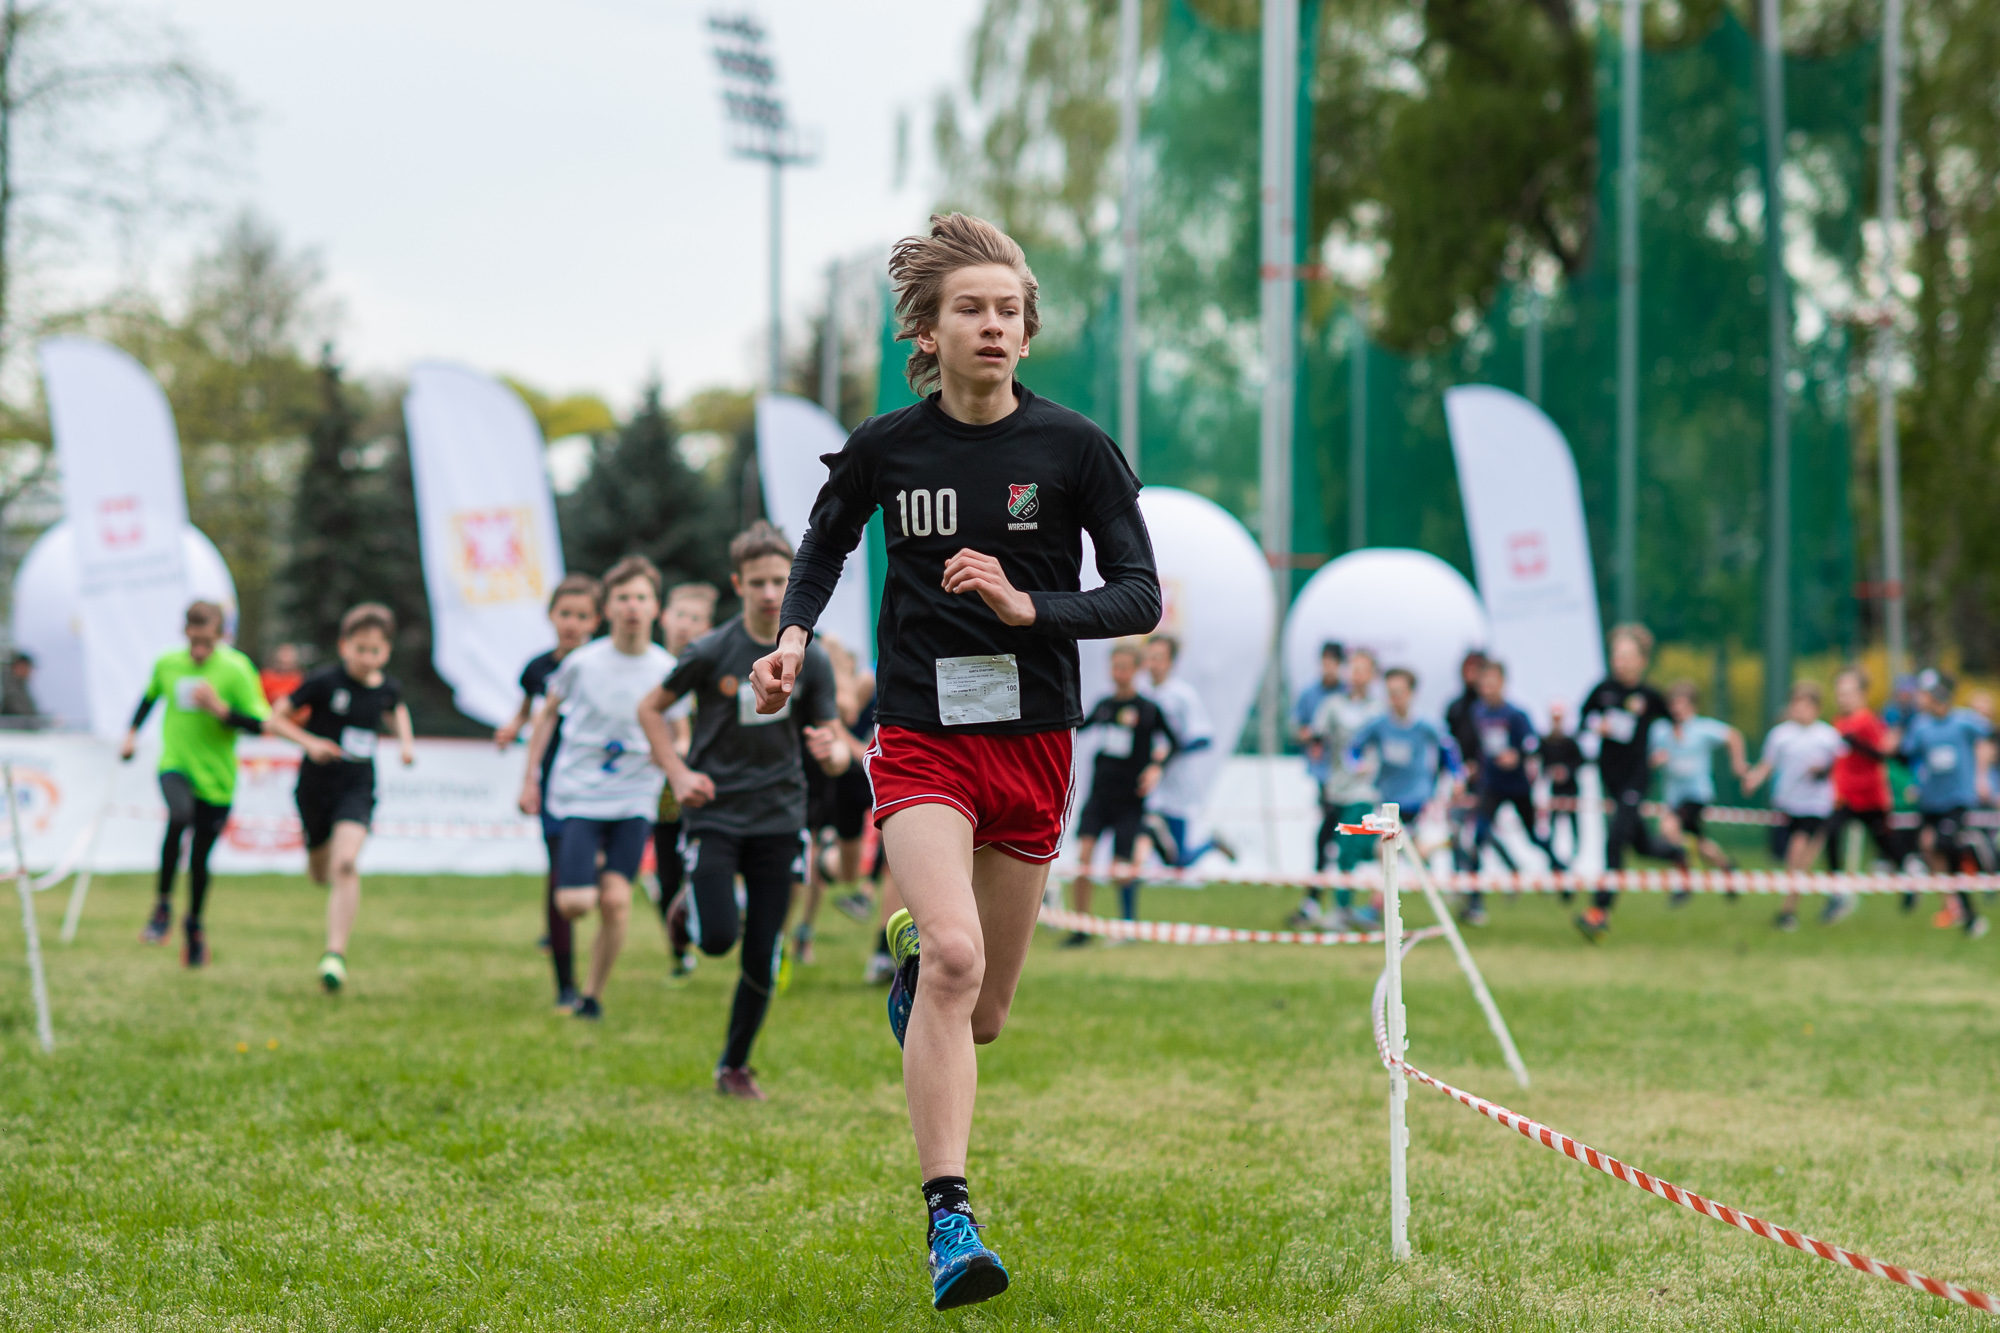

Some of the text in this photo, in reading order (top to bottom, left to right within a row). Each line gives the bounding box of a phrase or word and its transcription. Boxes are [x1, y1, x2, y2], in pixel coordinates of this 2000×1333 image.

[896, 487, 957, 537] 100
[1022, 502, 1036, 516] 1922
[1007, 522, 1038, 531] WARSZAWA
[1006, 684, 1017, 692] 100
